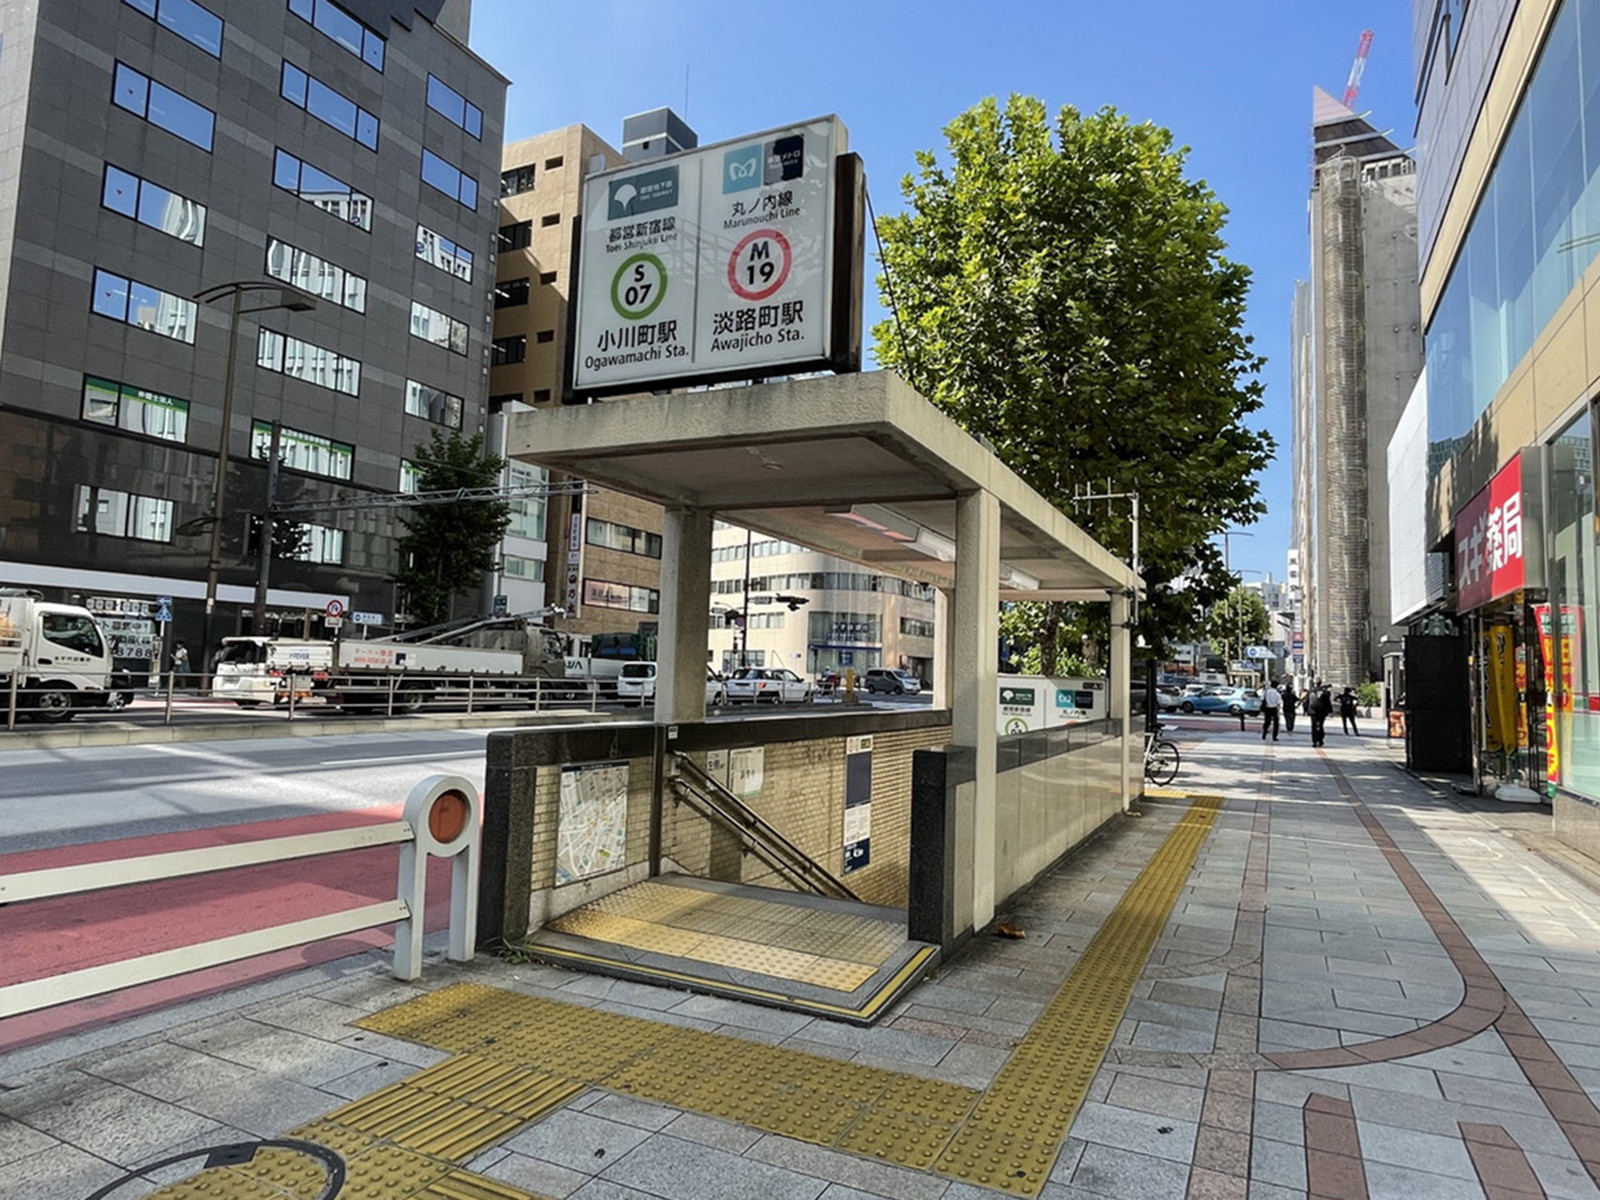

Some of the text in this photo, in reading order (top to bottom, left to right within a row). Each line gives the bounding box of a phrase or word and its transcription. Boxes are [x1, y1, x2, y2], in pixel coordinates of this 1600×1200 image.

[732, 190, 793, 218] 丸ノ内線
[609, 216, 676, 243] 都営新宿線
[723, 207, 800, 230] Marunouchi Line
[606, 233, 678, 254] Toei Shinjuku Line
[749, 240, 770, 262] M
[634, 264, 645, 283] S
[747, 262, 775, 286] 19
[625, 283, 652, 307] 07
[713, 300, 804, 336] 淡路町駅
[597, 320, 677, 352] 小川町駅
[711, 328, 805, 353] Awajicho Sta.
[585, 344, 690, 372] Ogawamachi Sta.
[1458, 491, 1522, 590] スギ薬局
